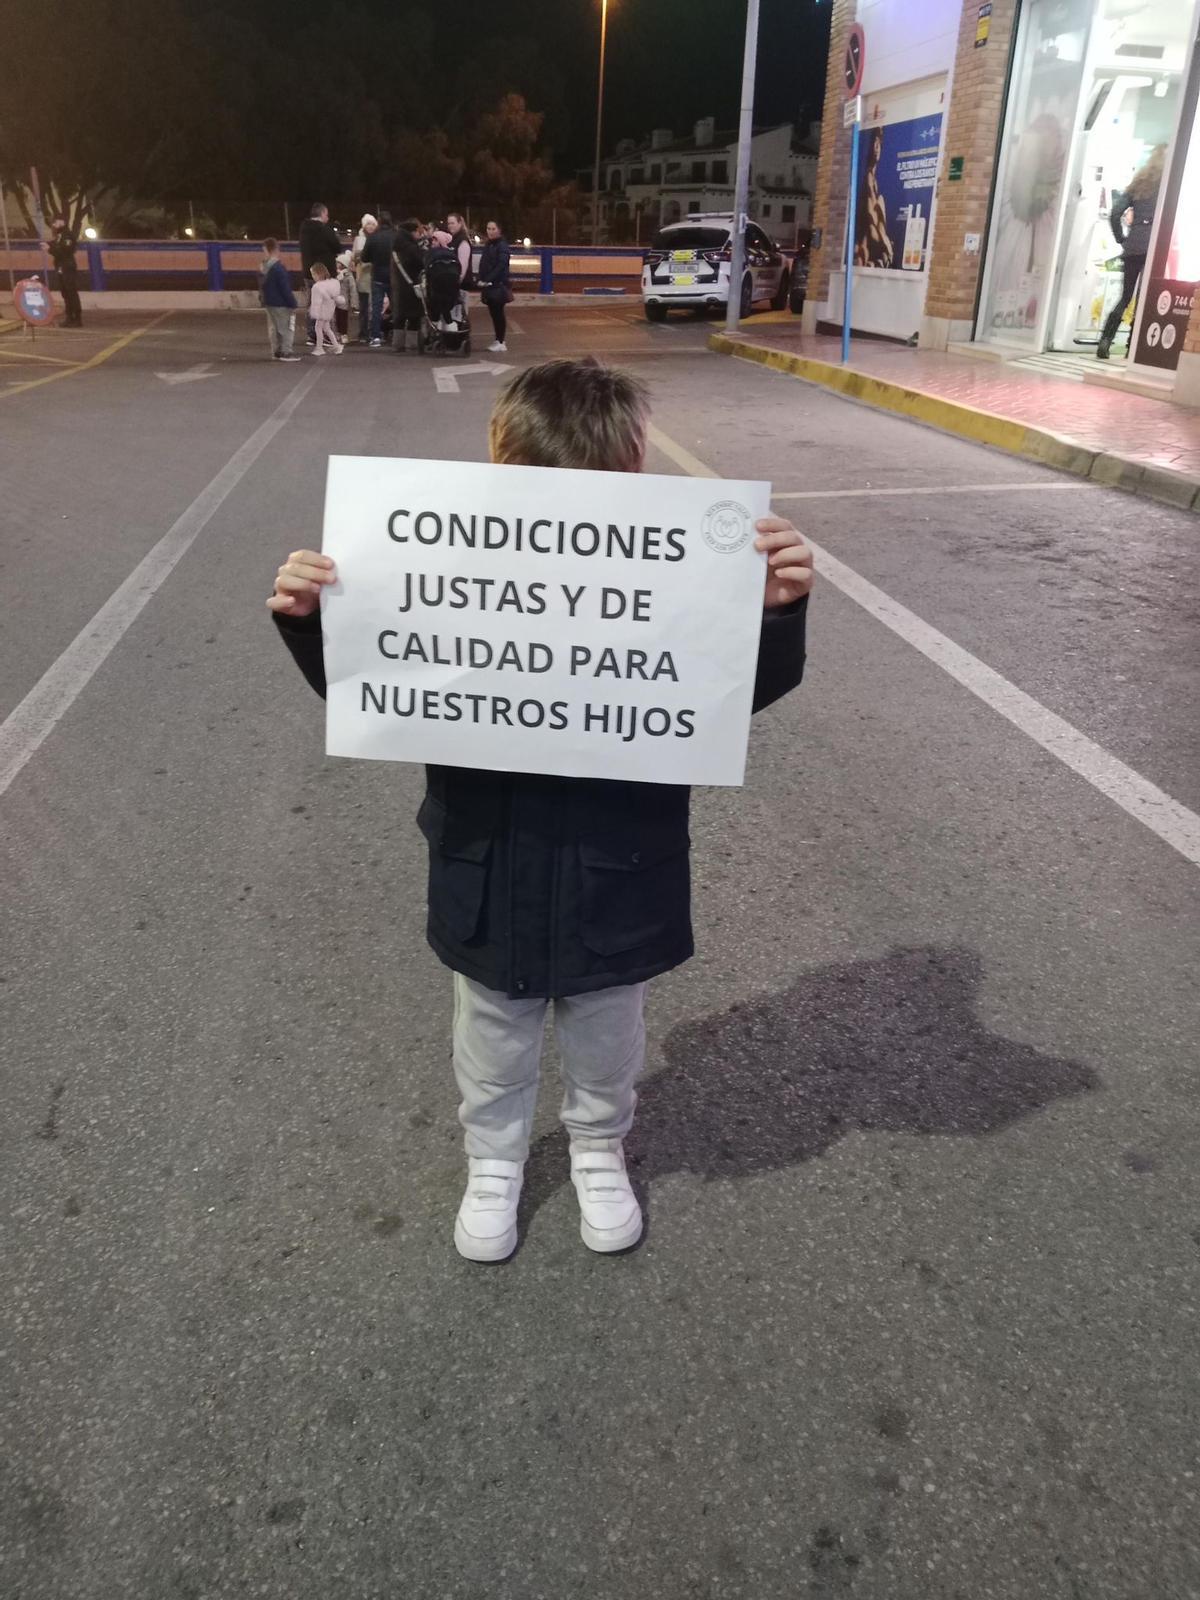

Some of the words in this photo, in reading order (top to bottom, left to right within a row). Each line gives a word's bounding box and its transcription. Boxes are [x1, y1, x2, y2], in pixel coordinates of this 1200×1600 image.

[1174, 295, 1188, 306] 744
[387, 509, 687, 562] CONDICIONES
[399, 572, 547, 615] JUSTAS
[560, 584, 586, 617] Y
[600, 587, 652, 622] DE
[377, 629, 553, 674] CALIDAD
[570, 645, 679, 682] PARA
[361, 682, 569, 731] NUESTROS
[584, 703, 696, 743] HIJOS
